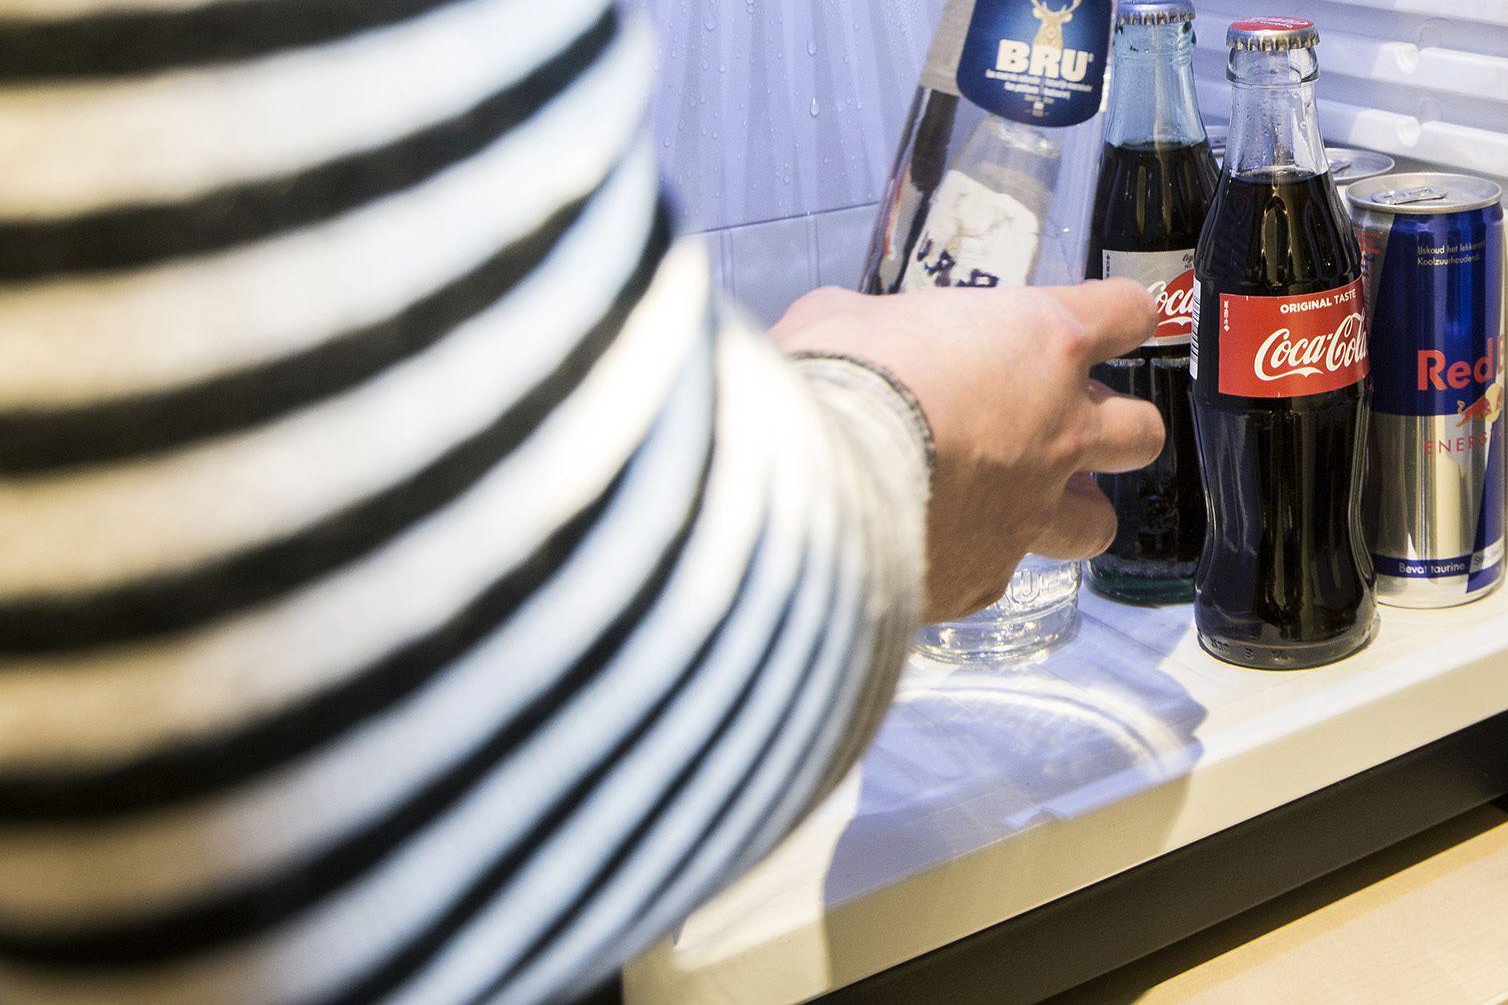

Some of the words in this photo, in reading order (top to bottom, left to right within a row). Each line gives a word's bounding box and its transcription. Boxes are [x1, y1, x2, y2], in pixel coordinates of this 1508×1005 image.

[995, 38, 1088, 82] BRU
[1280, 299, 1332, 315] ORIGINAL
[1333, 287, 1358, 306] TASTE
[1254, 311, 1368, 382] Coca-Cola
